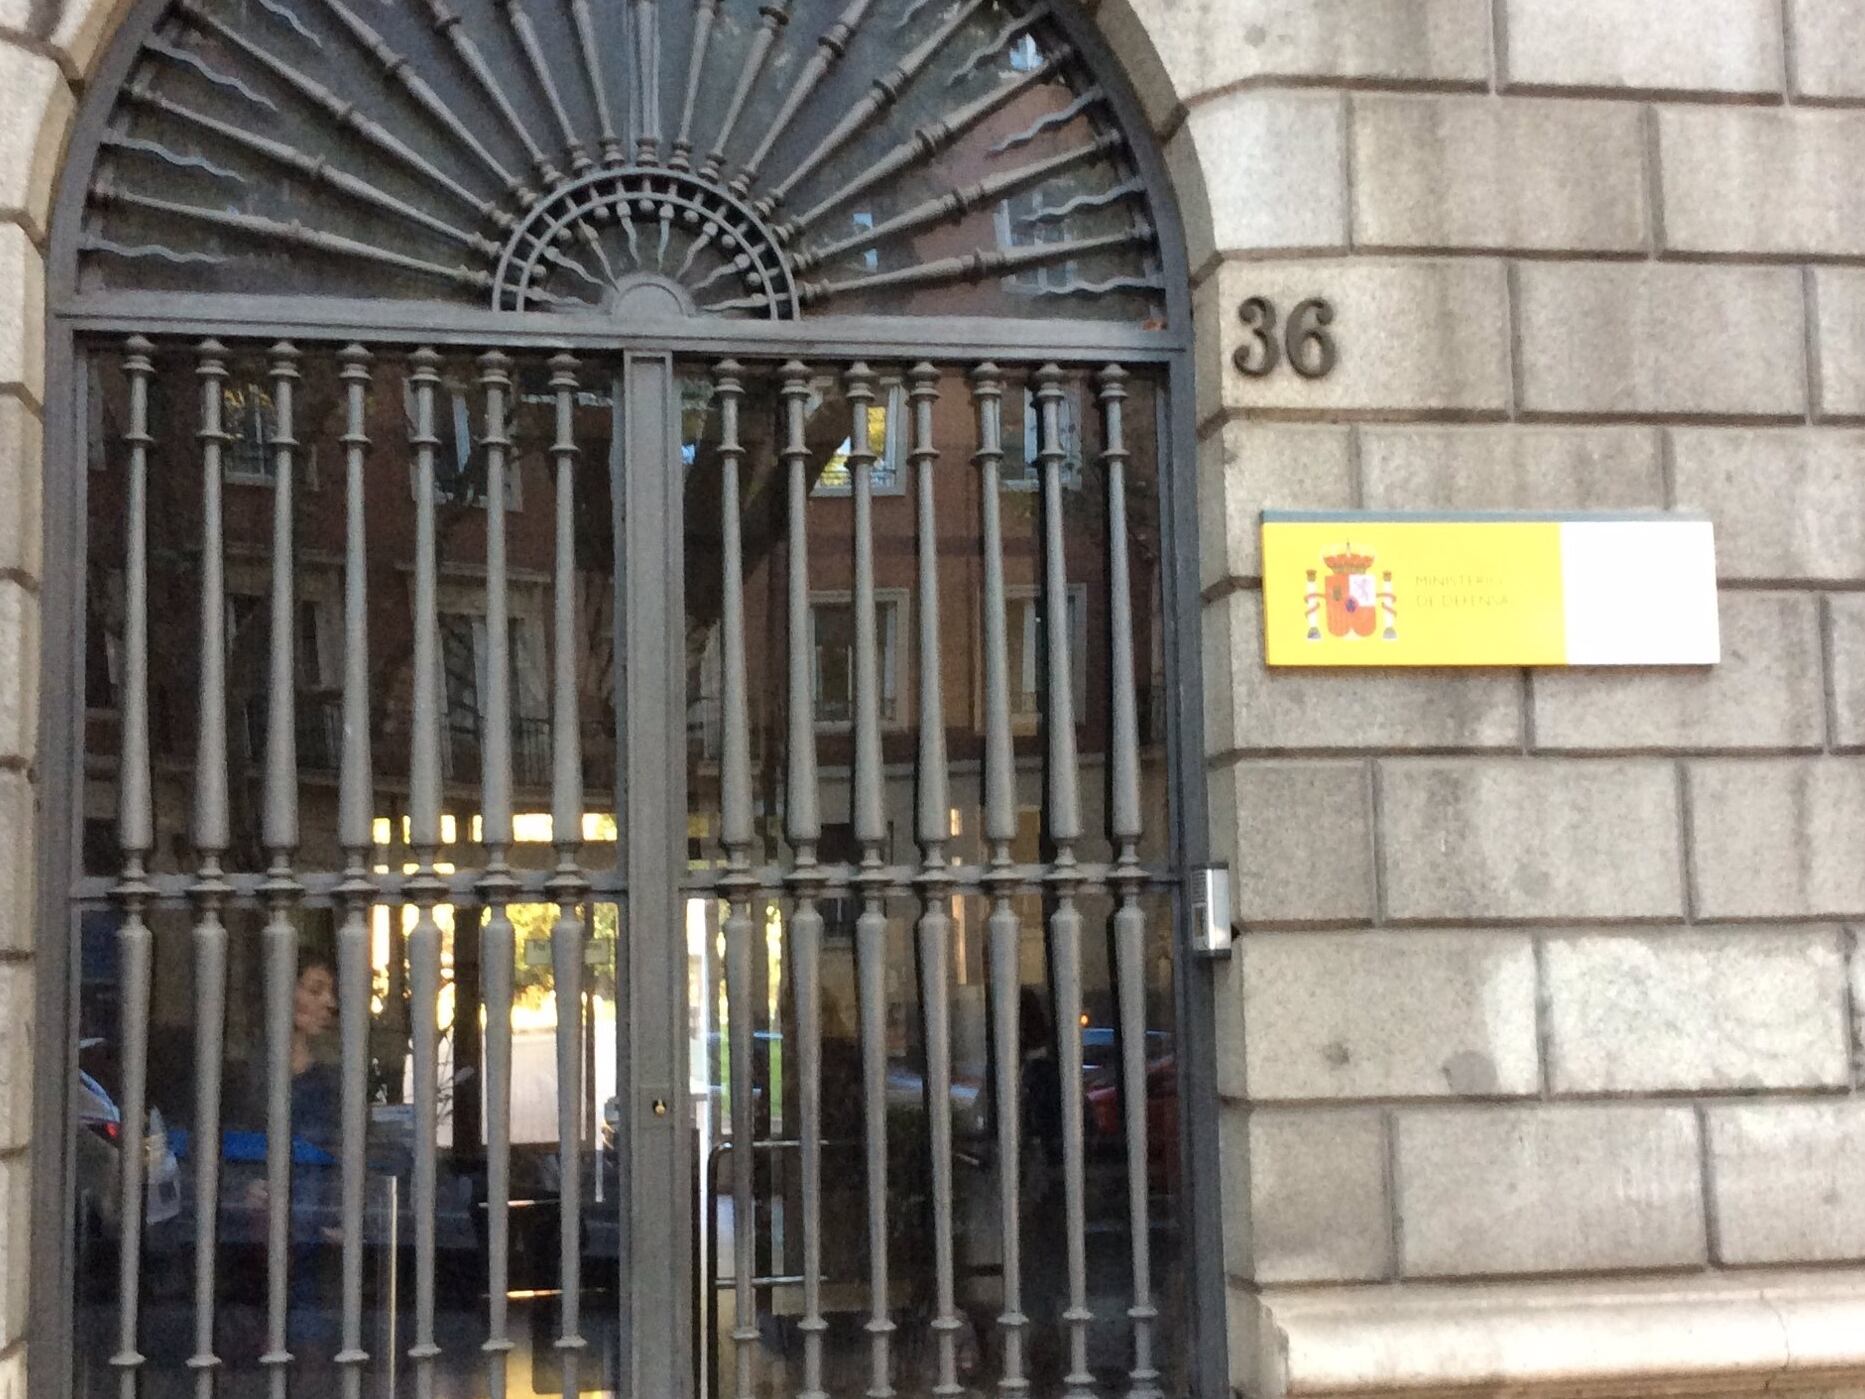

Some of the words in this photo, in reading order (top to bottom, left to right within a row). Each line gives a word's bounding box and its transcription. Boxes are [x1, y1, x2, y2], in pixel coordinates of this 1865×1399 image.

[1233, 296, 1336, 379] 36
[1416, 594, 1433, 608] DE
[1441, 594, 1509, 608] DEFENSA
